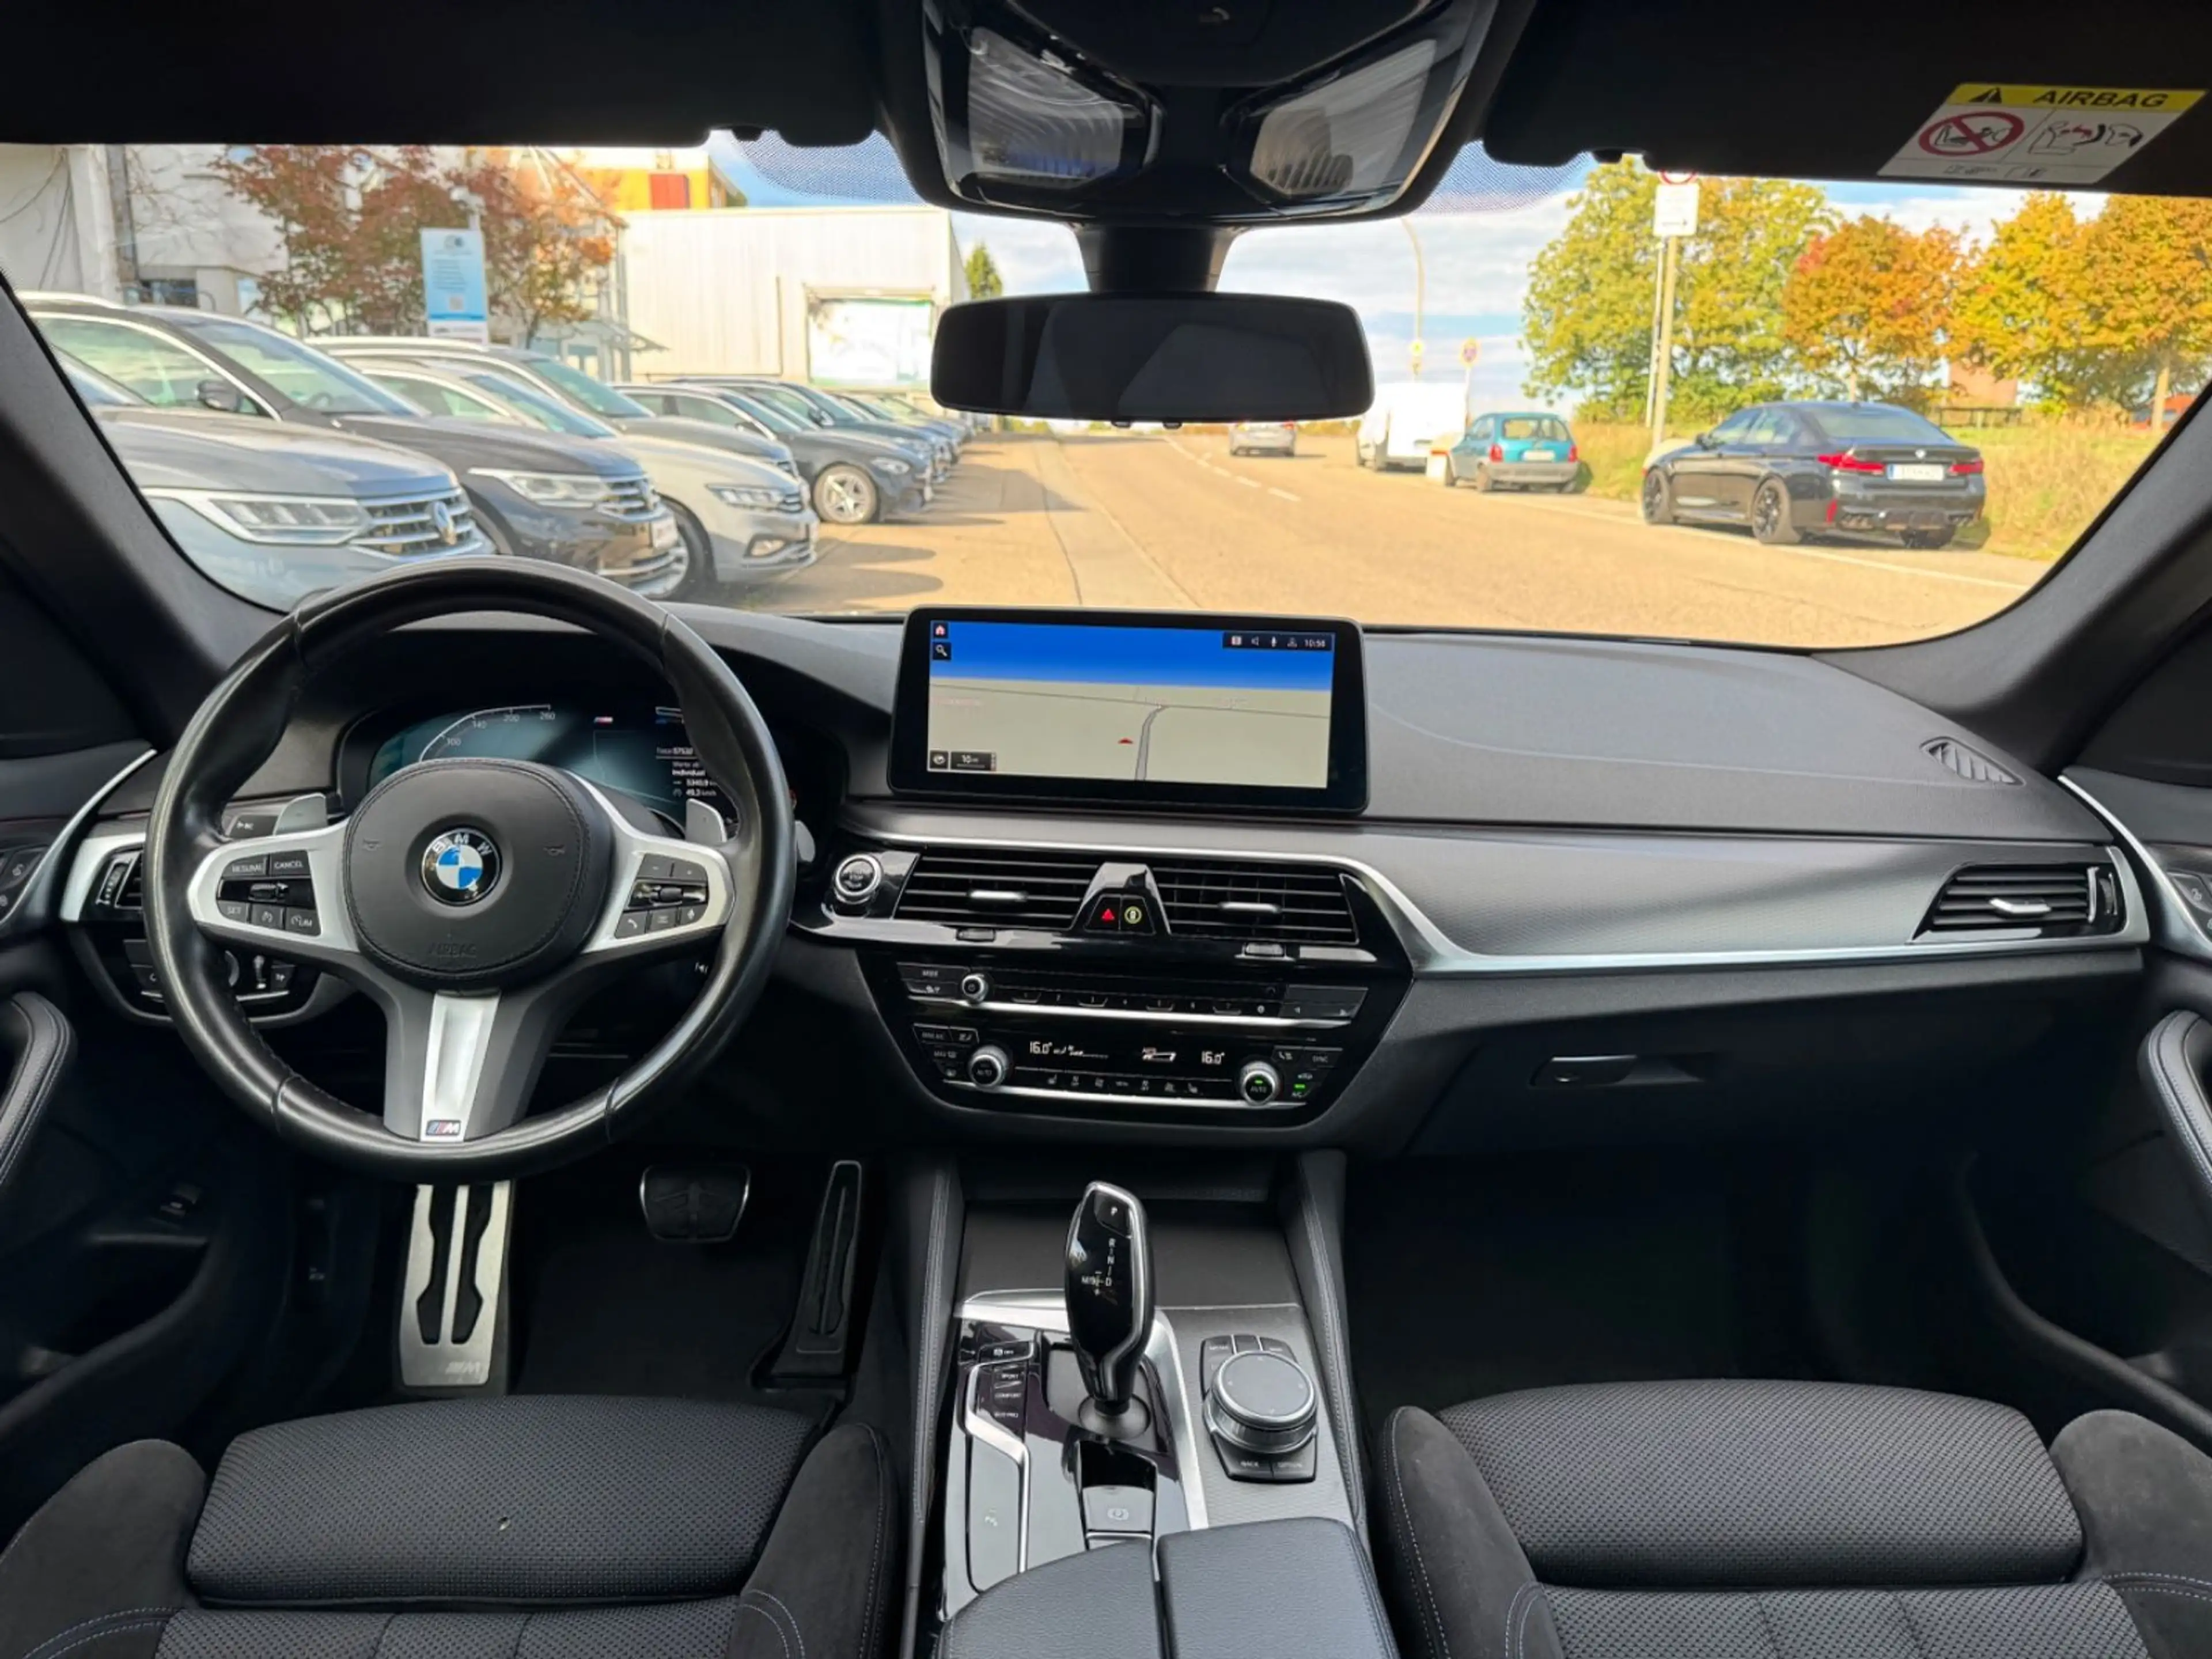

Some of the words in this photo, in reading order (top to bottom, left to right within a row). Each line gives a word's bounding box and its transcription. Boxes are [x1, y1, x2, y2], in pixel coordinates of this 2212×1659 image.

[2033, 90, 2169, 108] AIRBAG
[446, 738, 461, 746] 100
[432, 832, 493, 855] BMW
[232, 864, 263, 873] RESUME
[274, 860, 303, 869] CANCEL
[227, 906, 241, 914] SET
[1111, 1206, 1118, 1216] P
[1107, 1255, 1115, 1264] N
[1105, 1277, 1112, 1286] D
